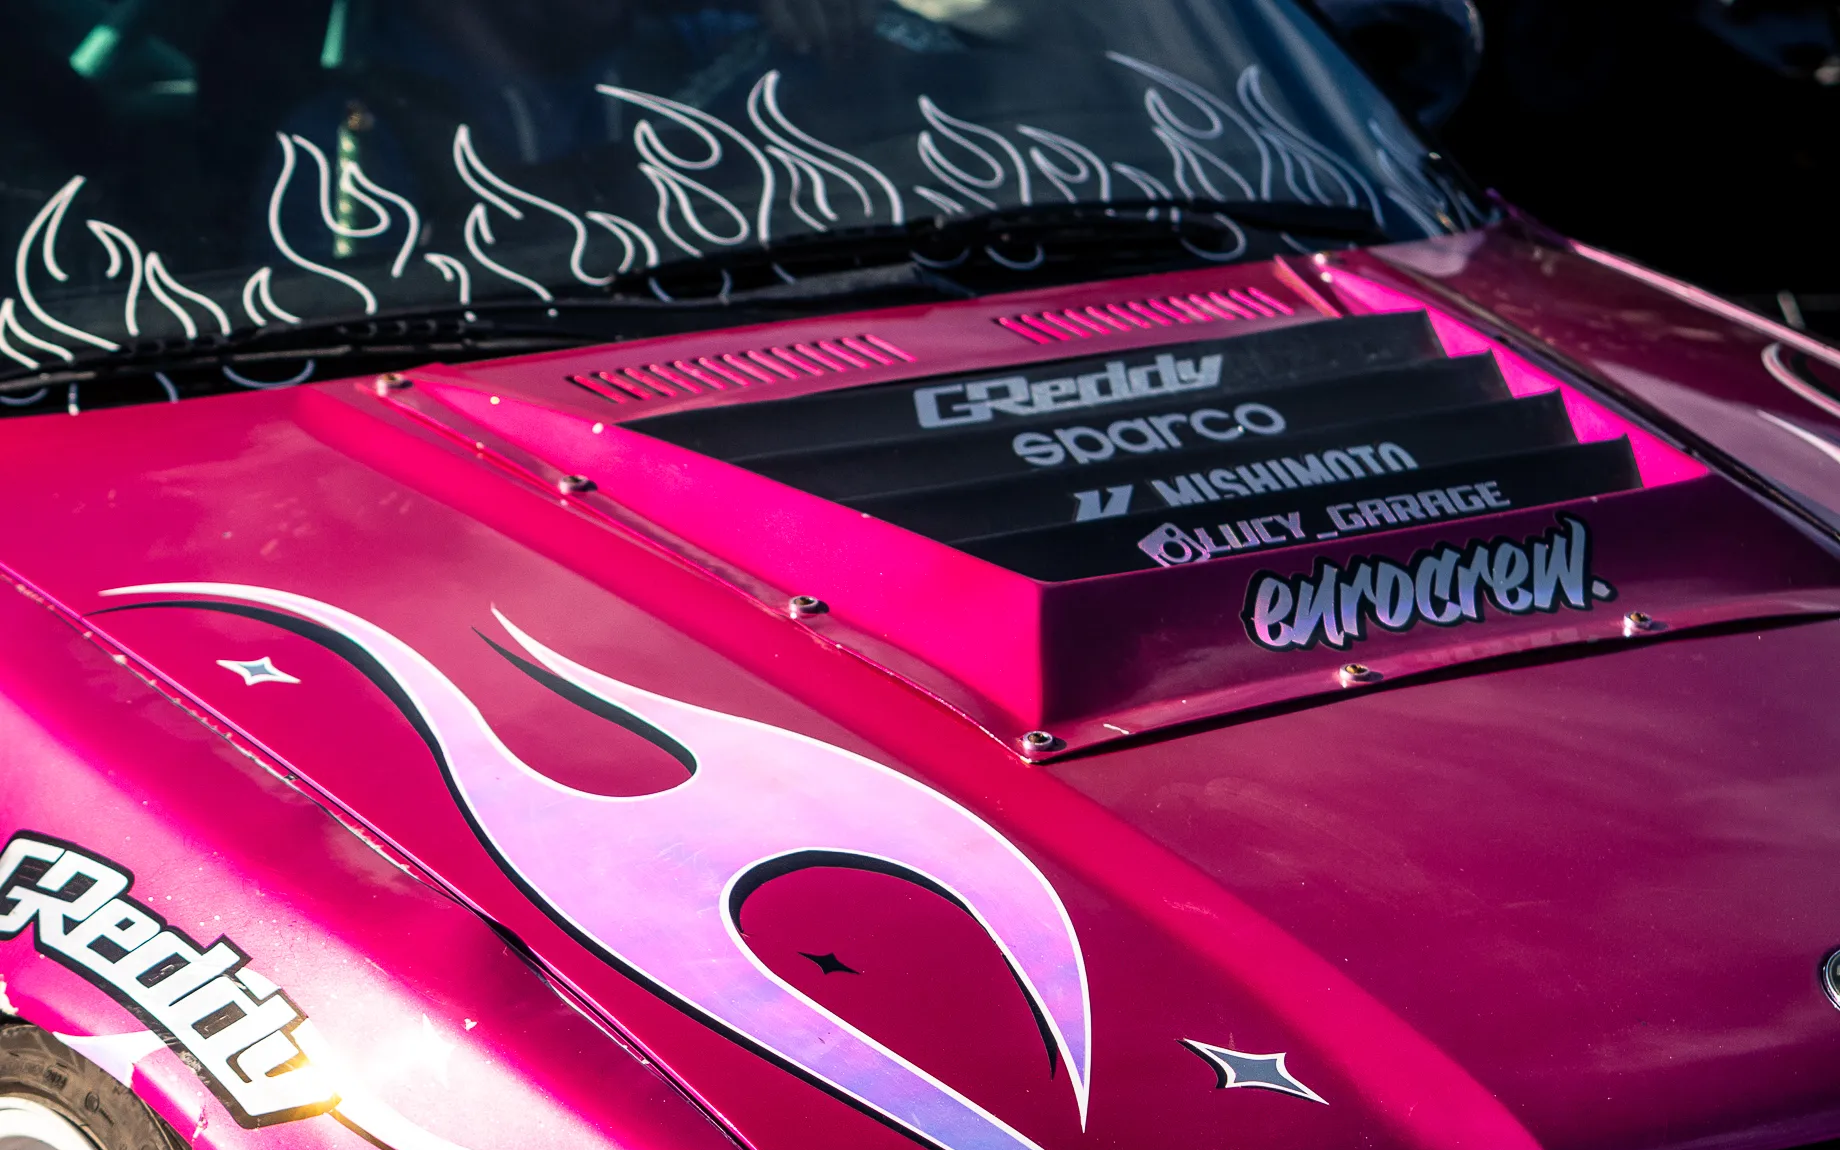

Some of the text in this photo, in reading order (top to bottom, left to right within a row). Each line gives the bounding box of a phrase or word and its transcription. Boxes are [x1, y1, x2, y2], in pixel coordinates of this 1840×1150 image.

[913, 354, 1222, 428] GReddy
[1012, 403, 1286, 466] sparco
[1152, 441, 1419, 507] MISHIMOTO
[0, 836, 332, 1118] GReddy
